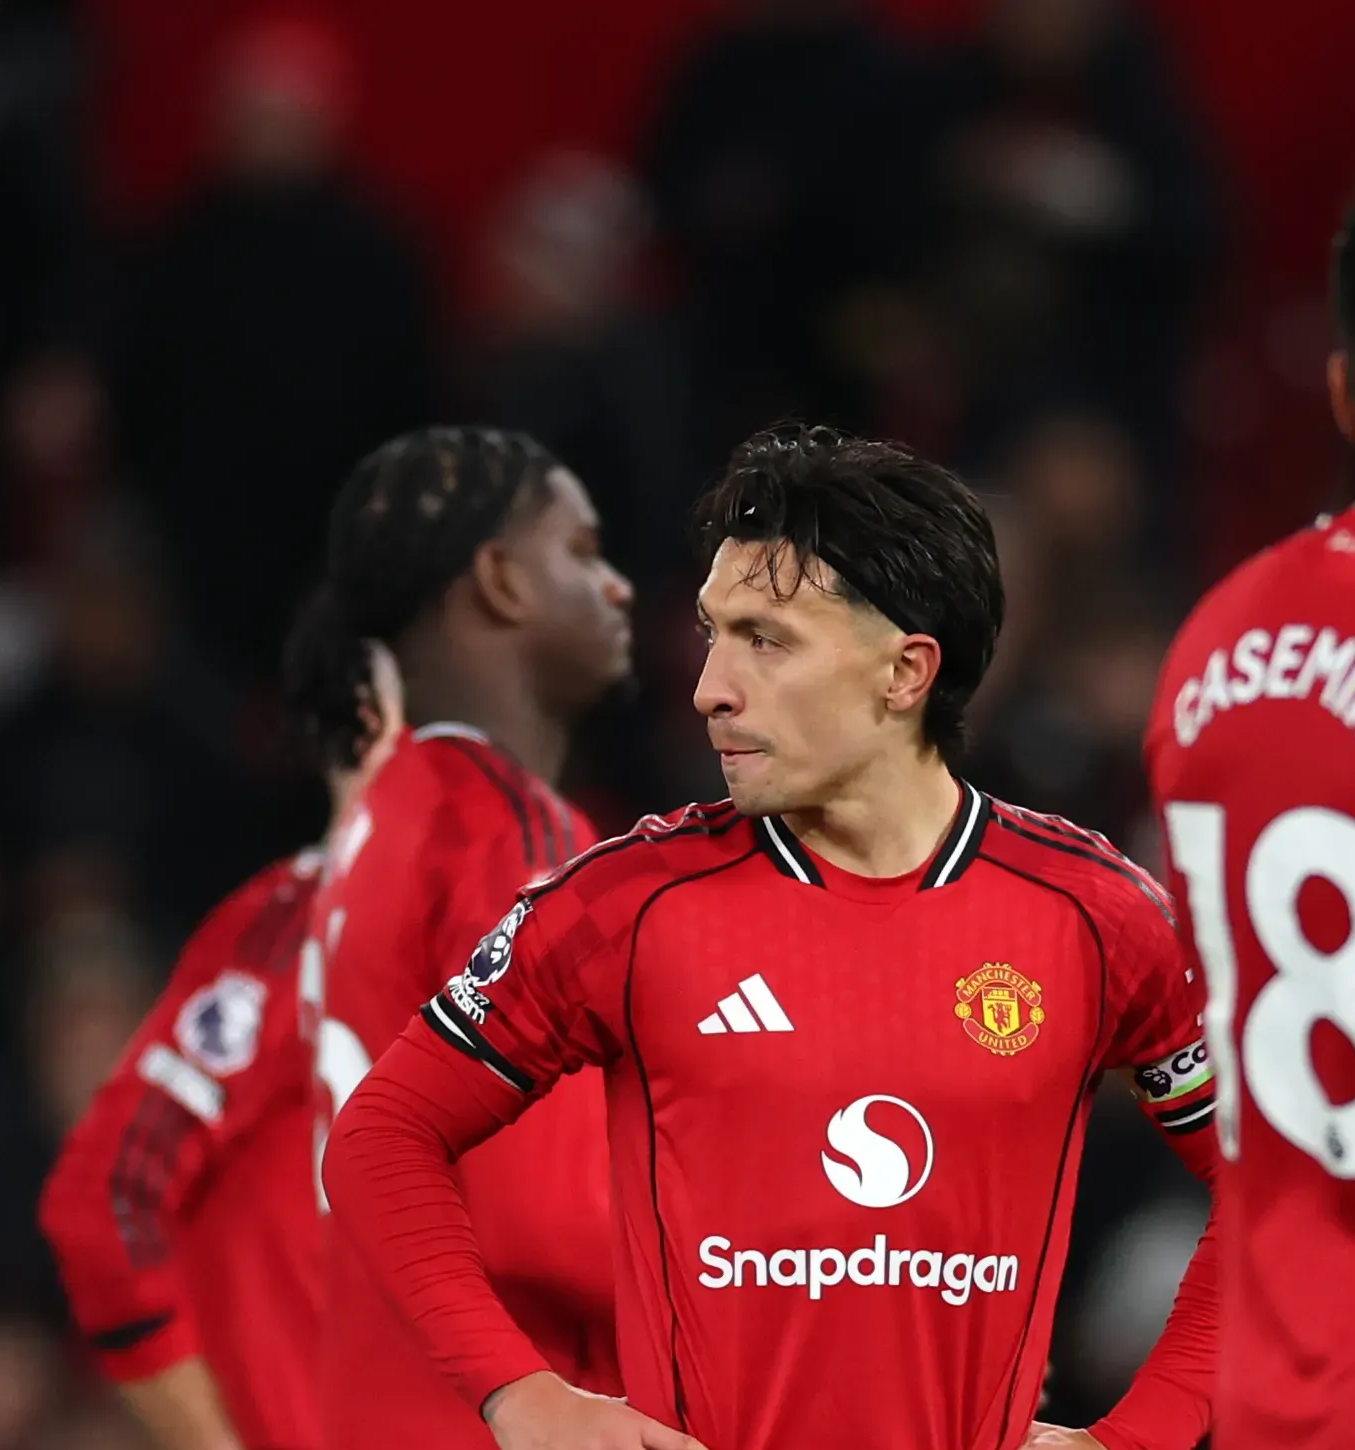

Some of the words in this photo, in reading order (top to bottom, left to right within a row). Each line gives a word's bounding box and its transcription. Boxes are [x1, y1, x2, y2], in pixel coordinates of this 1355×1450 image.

[962, 969, 1036, 1000] MANCHESTER
[978, 1031, 1027, 1049] UNITED
[698, 1233, 1019, 1306] Snapdragon
